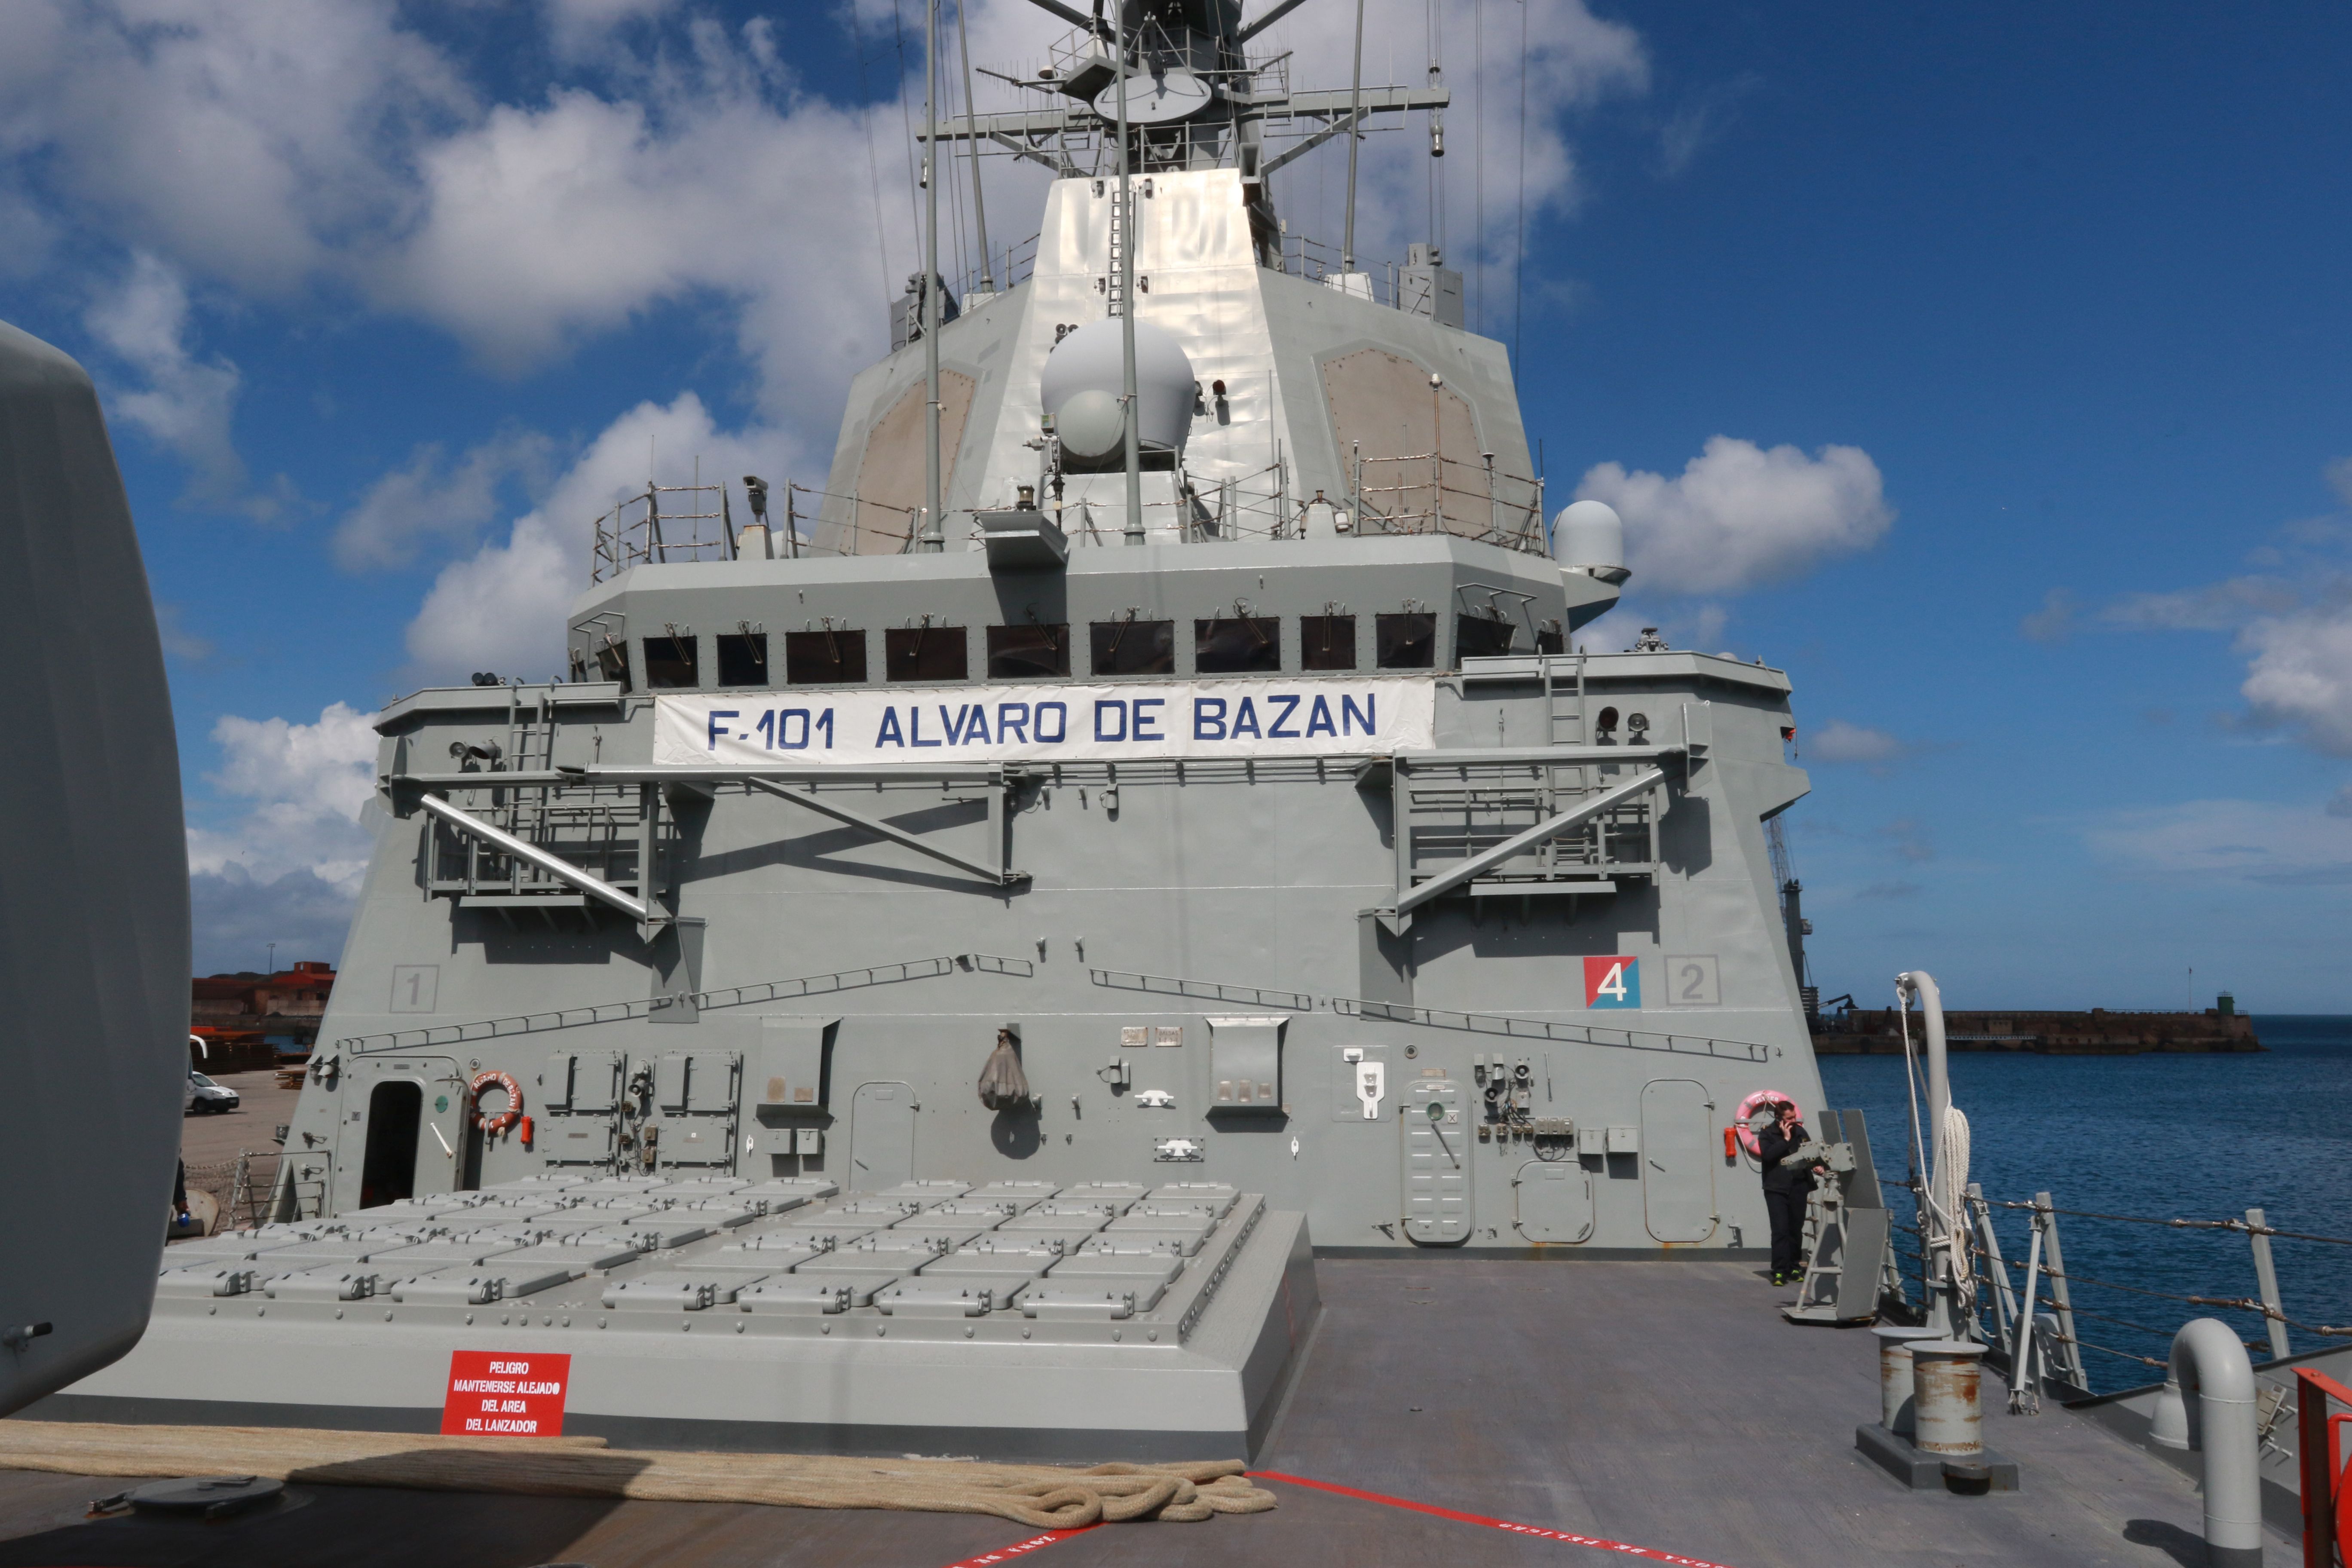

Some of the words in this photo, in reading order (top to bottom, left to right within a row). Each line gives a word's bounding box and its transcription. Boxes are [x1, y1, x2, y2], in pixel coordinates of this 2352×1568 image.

[708, 708, 834, 750] F-101
[876, 702, 1067, 747] ALVARO
[1095, 699, 1165, 741] DE
[1193, 693, 1376, 741] BAZAN
[407, 973, 420, 1005] 1
[1597, 962, 1627, 1001] 4
[1681, 964, 1704, 999] 2
[489, 1361, 529, 1375] PELIGRO
[453, 1379, 516, 1393] MANTENERSE
[517, 1381, 560, 1395] ALEJADO
[481, 1399, 499, 1412] DEL
[500, 1400, 526, 1413] AREA
[466, 1418, 483, 1431] DEL
[485, 1419, 537, 1433] LANZADOR
[1499, 1523, 1600, 1545] PELIGRO
[1007, 1535, 1056, 1553] ZONA
[1614, 1545, 1647, 1553] DE
